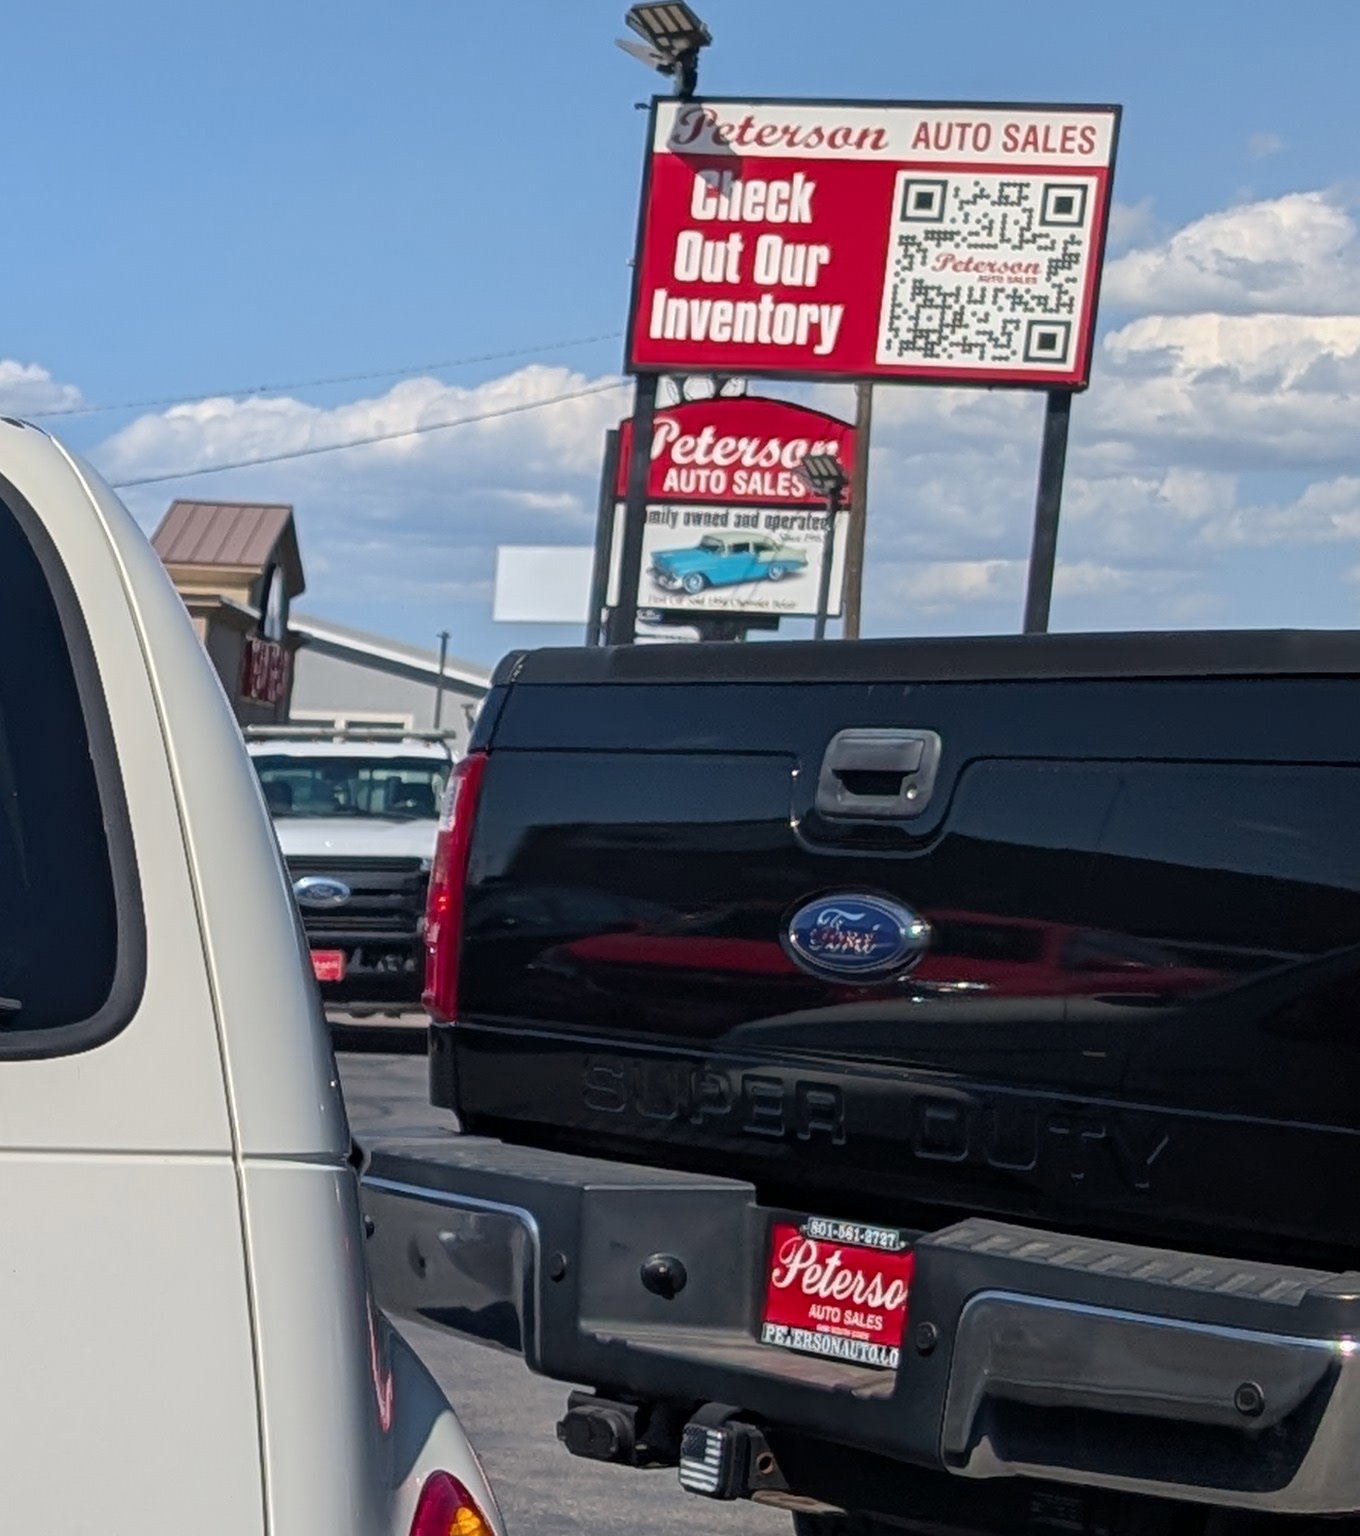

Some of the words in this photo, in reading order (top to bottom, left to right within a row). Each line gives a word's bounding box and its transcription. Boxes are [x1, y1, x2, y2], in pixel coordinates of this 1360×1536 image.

[672, 108, 889, 151] Peterson
[911, 121, 992, 152] AUTO
[1002, 123, 1097, 154] SALES
[690, 169, 817, 224] Check
[673, 229, 745, 285] Out
[753, 233, 832, 288] Our
[931, 253, 1041, 275] Peterson
[648, 287, 846, 356] Inventory
[662, 467, 728, 495] AUTO
[732, 469, 807, 498] SALES
[647, 506, 679, 530] mily
[682, 508, 730, 528] owned
[733, 510, 761, 529] and
[582, 1054, 848, 1147] SUPER
[771, 1235, 909, 1311] Peterso
[808, 1303, 841, 1323] AUTO
[843, 1308, 884, 1332] SALES
